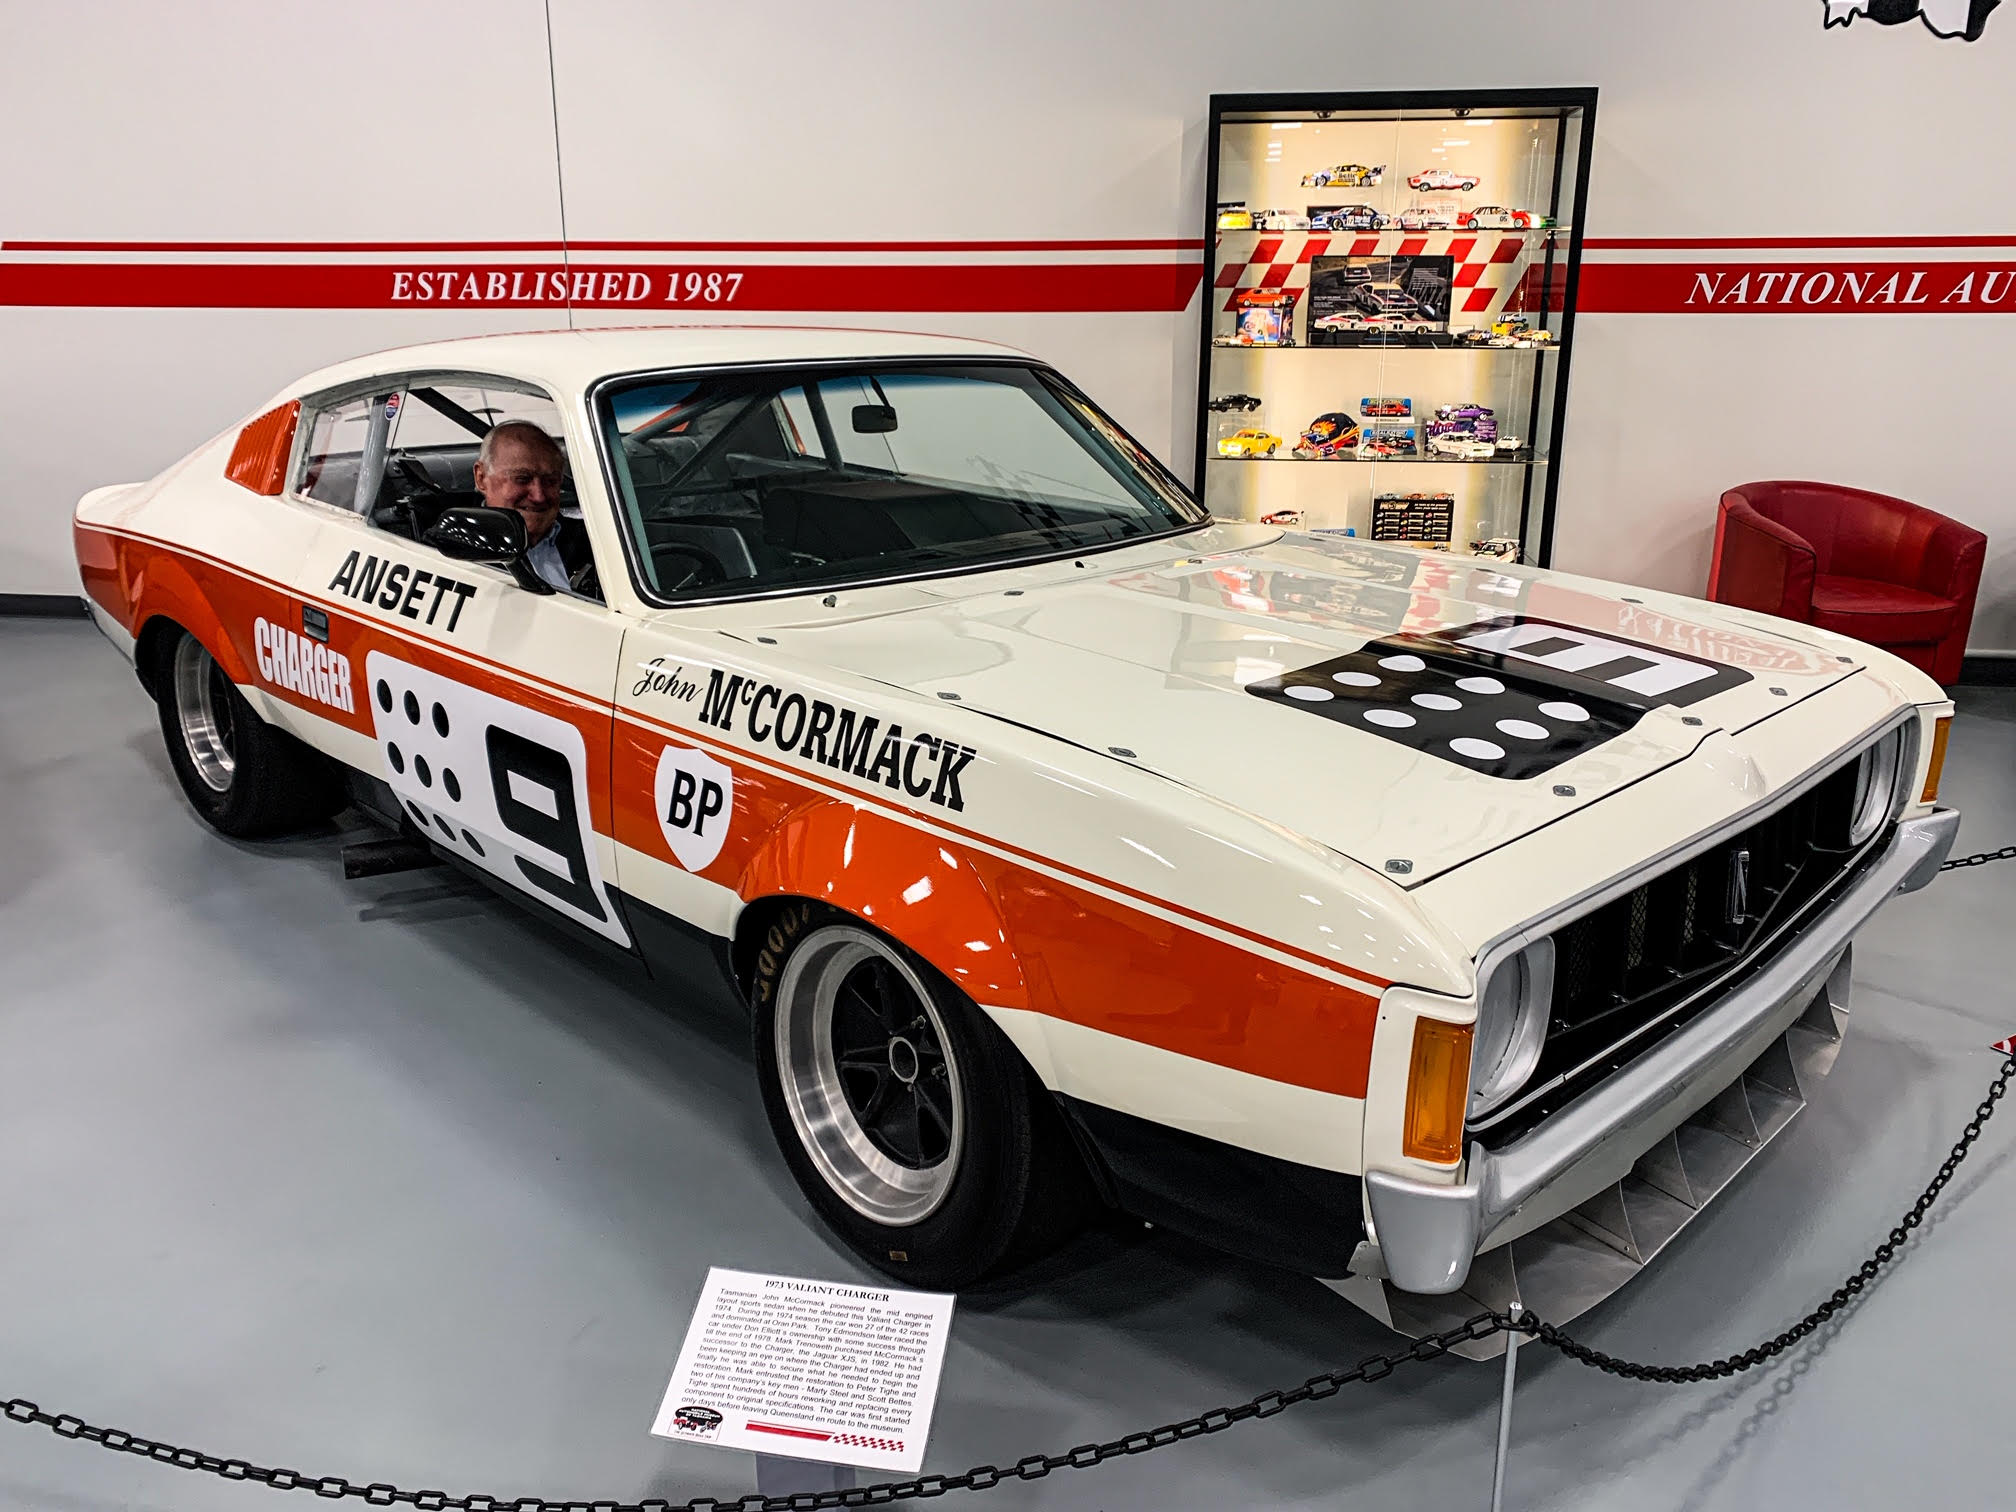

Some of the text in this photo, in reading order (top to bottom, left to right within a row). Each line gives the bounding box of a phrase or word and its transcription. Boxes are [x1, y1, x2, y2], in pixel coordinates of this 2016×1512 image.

[391, 271, 743, 302] ESTABLISHED 1987
[1685, 271, 2016, 304] NATIONAL AU
[328, 550, 477, 633] ANSETT
[253, 616, 355, 714] CHARGER
[632, 658, 977, 812] John McCORMACK
[666, 768, 724, 837] BP
[485, 723, 608, 923] 9
[720, 1287, 757, 1298] Tasmanian
[761, 1293, 779, 1301] John
[783, 1295, 825, 1307] McCormack
[829, 1303, 865, 1312] pioneered
[904, 1311, 933, 1320] engined
[765, 1279, 889, 1302] 1973 VALIANT CHARGER
[716, 1295, 738, 1304] layout
[763, 1302, 784, 1310] sedan
[819, 1308, 849, 1318] debuted
[866, 1314, 891, 1323] Valiant
[892, 1317, 922, 1328] Charger
[725, 1314, 762, 1323] dominated
[771, 1319, 789, 1327] Oran
[814, 1324, 832, 1334] Tony
[737, 1306, 760, 1316] During
[776, 1311, 793, 1319] 1974
[794, 1315, 820, 1323] season
[909, 1327, 929, 1336] races
[702, 1337, 738, 1346] successor
[764, 1343, 794, 1356] Charger,
[798, 1348, 810, 1356] the
[812, 1350, 838, 1359] Jaguar
[839, 1354, 857, 1364] XJS,
[907, 1363, 922, 1371] had
[743, 1323, 759, 1331] Don
[788, 1331, 825, 1342] ownership
[866, 1341, 896, 1349] success
[898, 1344, 925, 1355] through
[774, 1336, 792, 1345] Mark
[833, 1345, 872, 1356] purchased
[696, 1352, 717, 1362] finally
[719, 1355, 729, 1363] he
[779, 1364, 804, 1373] secure
[807, 1368, 825, 1376] what
[840, 1370, 869, 1381] needed
[882, 1378, 902, 1387] begin
[699, 1344, 717, 1352] been
[718, 1346, 747, 1358] keeping
[759, 1353, 773, 1361] eye
[785, 1356, 808, 1364] where
[822, 1360, 852, 1371] Charger
[869, 1368, 893, 1376] ended
[688, 1377, 708, 1387] Tighe
[709, 1382, 730, 1390] spent
[731, 1384, 766, 1395] hundreds
[777, 1390, 798, 1399] hours
[800, 1395, 836, 1406] reworking
[854, 1402, 889, 1414] replacing
[890, 1407, 912, 1417] every
[690, 1369, 703, 1377] two
[714, 1372, 725, 1380] his
[727, 1375, 765, 1386] company's
[767, 1379, 781, 1389] key
[806, 1385, 828, 1396] Marty
[829, 1388, 849, 1397] Steel
[866, 1393, 887, 1402] Scott
[735, 1366, 753, 1375] Mark
[755, 1370, 790, 1380] entrusted
[791, 1374, 803, 1382] the
[805, 1377, 844, 1387] restoration
[856, 1383, 876, 1391] Peter
[879, 1385, 899, 1396] Tighe
[681, 1396, 697, 1405] only
[697, 1398, 715, 1407] days
[716, 1400, 740, 1409] before
[741, 1403, 768, 1415] leaving
[769, 1408, 814, 1421] Queensland
[826, 1417, 846, 1425] route
[856, 1420, 869, 1428] the
[684, 1387, 725, 1398] component
[735, 1395, 763, 1403] original
[819, 1405, 833, 1413] The
[867, 1412, 882, 1420] first
[883, 1415, 910, 1424] started
